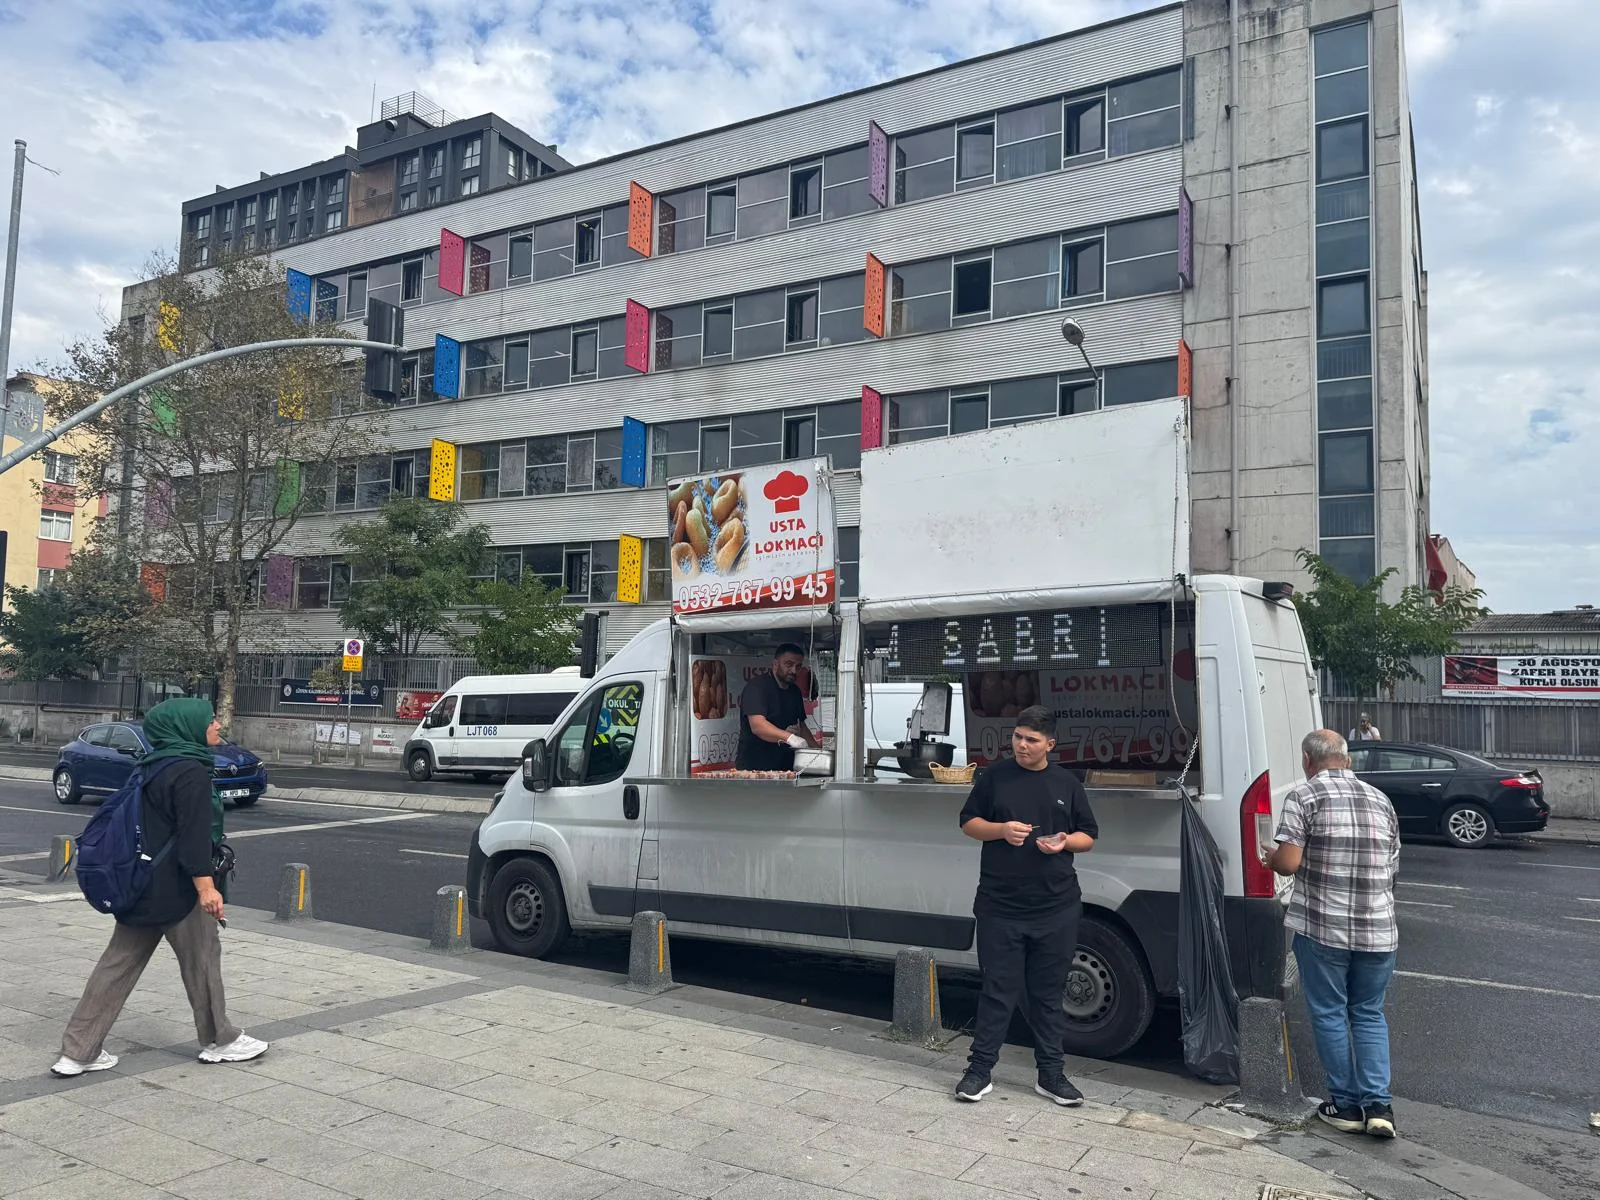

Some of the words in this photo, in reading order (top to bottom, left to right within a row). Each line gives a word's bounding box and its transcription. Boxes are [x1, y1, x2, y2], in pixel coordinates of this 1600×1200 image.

[770, 518, 806, 533] USTA
[755, 535, 824, 554] LOKMACI
[679, 583, 723, 609] 0532
[728, 578, 764, 605] 767
[770, 576, 794, 602] 99
[801, 573, 828, 599] 45
[1517, 658, 1537, 667] 30
[1511, 668, 1556, 677] ZAFER
[1050, 673, 1165, 693] LOKMACI
[1519, 678, 1556, 687] KUTLU
[1561, 678, 1599, 687] OLSUN
[608, 699, 629, 709] OKUL
[1070, 726, 1135, 763] 767
